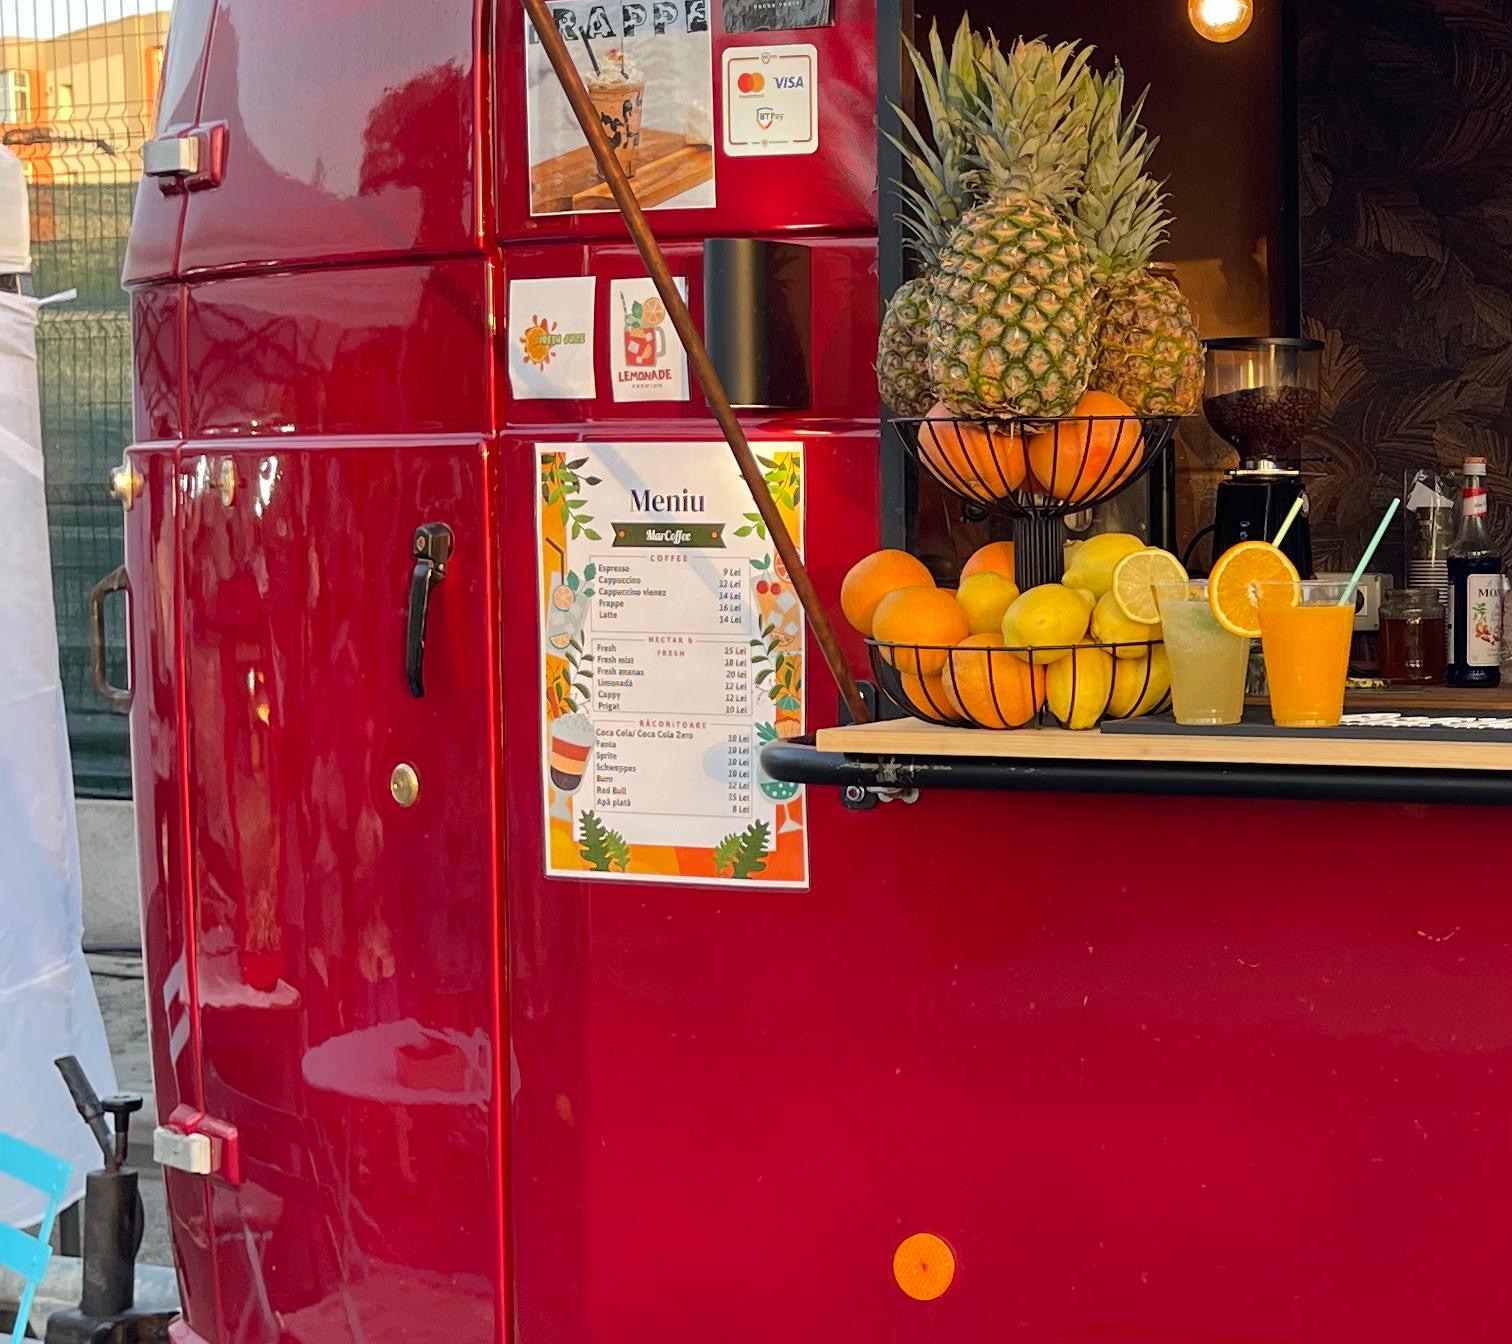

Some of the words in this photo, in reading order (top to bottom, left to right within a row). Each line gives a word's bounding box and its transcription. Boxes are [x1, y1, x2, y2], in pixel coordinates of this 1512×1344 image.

[774, 76, 804, 89] VISA
[539, 334, 561, 345] FRESH
[563, 333, 585, 345] JUICE
[618, 369, 672, 382] LEMONADE
[630, 488, 705, 512] Meniu
[646, 530, 692, 544] MarCoffee
[598, 564, 629, 574] Espresso
[598, 576, 641, 586] Cappuccino
[719, 580, 728, 588] 12
[730, 580, 741, 588] Lei
[599, 588, 641, 597] Cappuccino
[719, 592, 728, 600] 14
[730, 592, 741, 600] Lei
[599, 600, 624, 609] Frappe
[600, 611, 617, 619] Latte
[648, 636, 683, 644] NECTAR
[597, 644, 616, 652] Fresh
[724, 647, 734, 655] 15
[735, 647, 746, 655] Lei
[597, 656, 617, 664] Fresh
[736, 659, 747, 667] Lei
[597, 667, 617, 675] Fresh
[726, 671, 735, 679] 20
[736, 683, 747, 691] Lei
[598, 691, 621, 700] Cappy
[725, 694, 735, 702] 12
[736, 694, 747, 702] Lei
[598, 703, 620, 711] Prigat
[736, 706, 747, 714] Lei
[637, 730, 655, 738] Coca
[676, 731, 693, 739] Zero
[739, 735, 749, 743] Lei
[596, 752, 617, 761] Sprite
[728, 758, 737, 766] 10
[739, 770, 749, 778] Lei
[728, 782, 737, 790] 12
[739, 782, 749, 790] Lei
[612, 787, 627, 795] Bull
[739, 794, 749, 802] Lei
